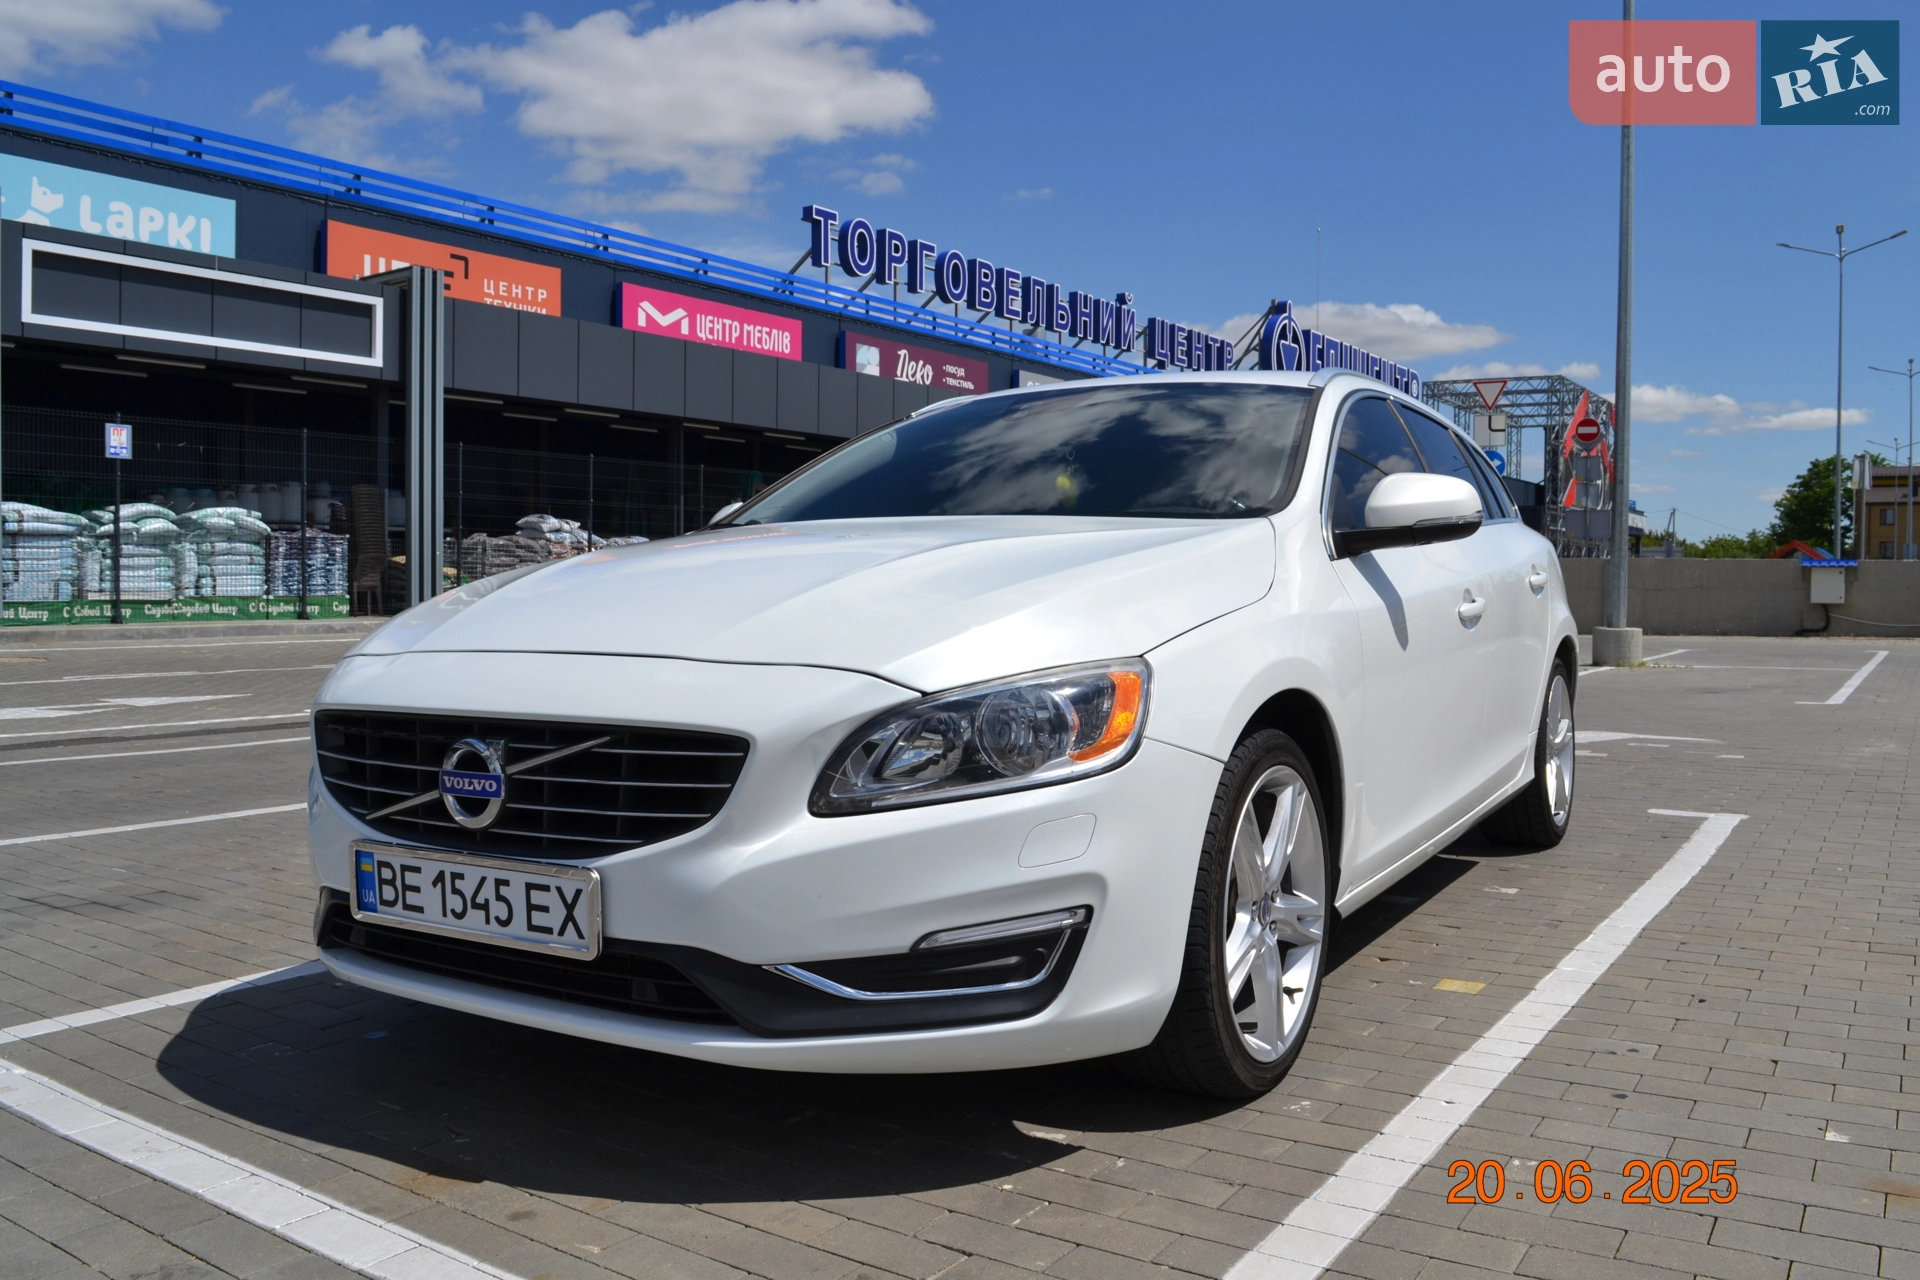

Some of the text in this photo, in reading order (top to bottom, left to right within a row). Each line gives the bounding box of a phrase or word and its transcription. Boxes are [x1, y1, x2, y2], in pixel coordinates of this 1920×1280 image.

[483, 278, 548, 303] ЦЕНТР
[802, 204, 1235, 372] ТОРГОВЕЛЬНИЙ ЦЕНТР
[696, 313, 791, 354] ЦЕНТР МЕБЛІВ
[442, 775, 498, 792] VOLVO
[362, 860, 586, 941] UA BE 1545 EX
